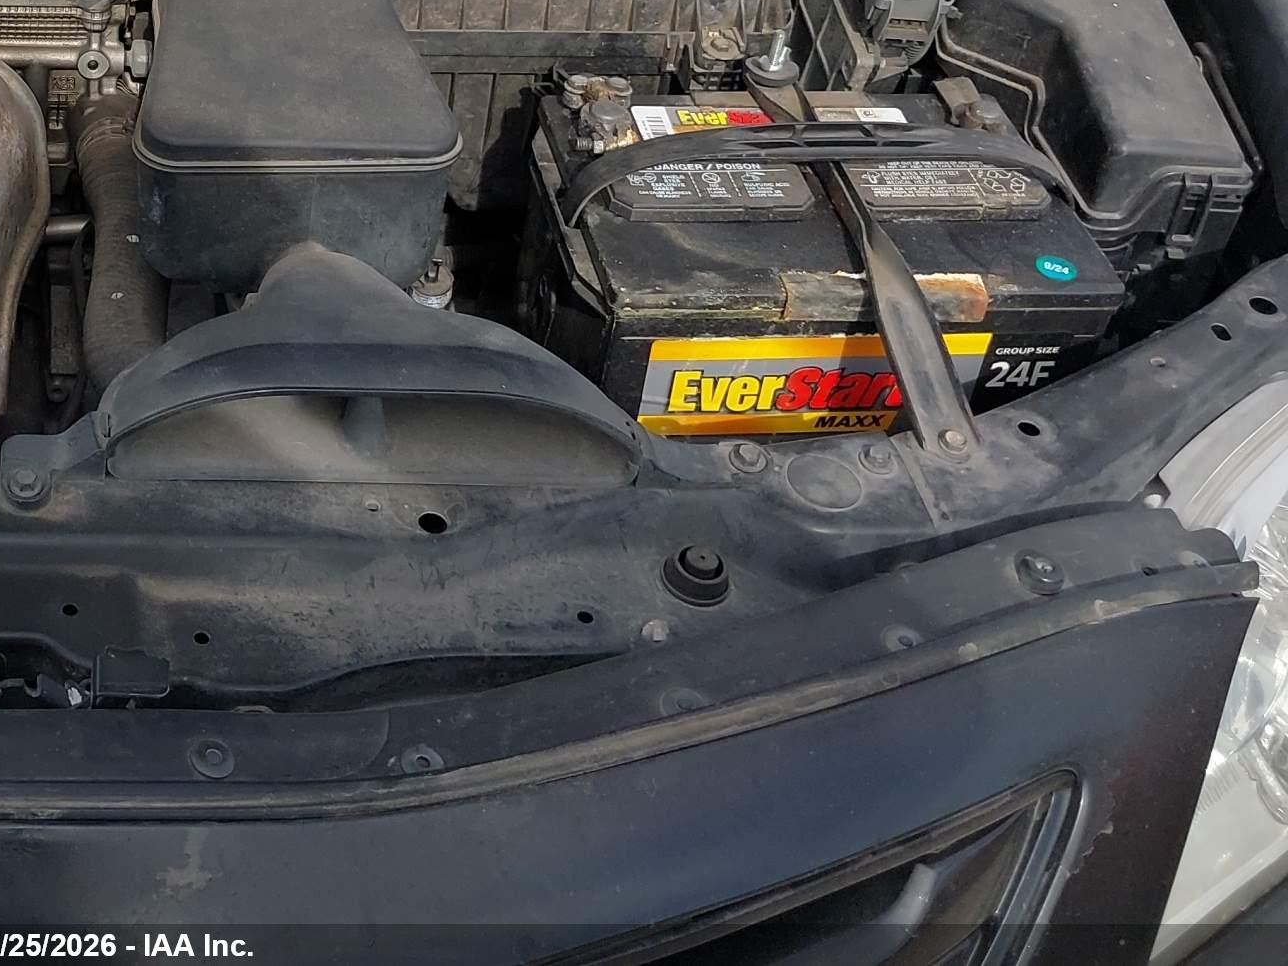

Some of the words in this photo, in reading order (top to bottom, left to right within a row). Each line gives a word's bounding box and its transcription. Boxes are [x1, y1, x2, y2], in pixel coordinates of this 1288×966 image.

[716, 162, 761, 171] POISON
[995, 347, 1035, 356] GROUP
[1035, 346, 1061, 354] SIZE
[984, 361, 1056, 388] 24F
[814, 414, 885, 429] MAXX
